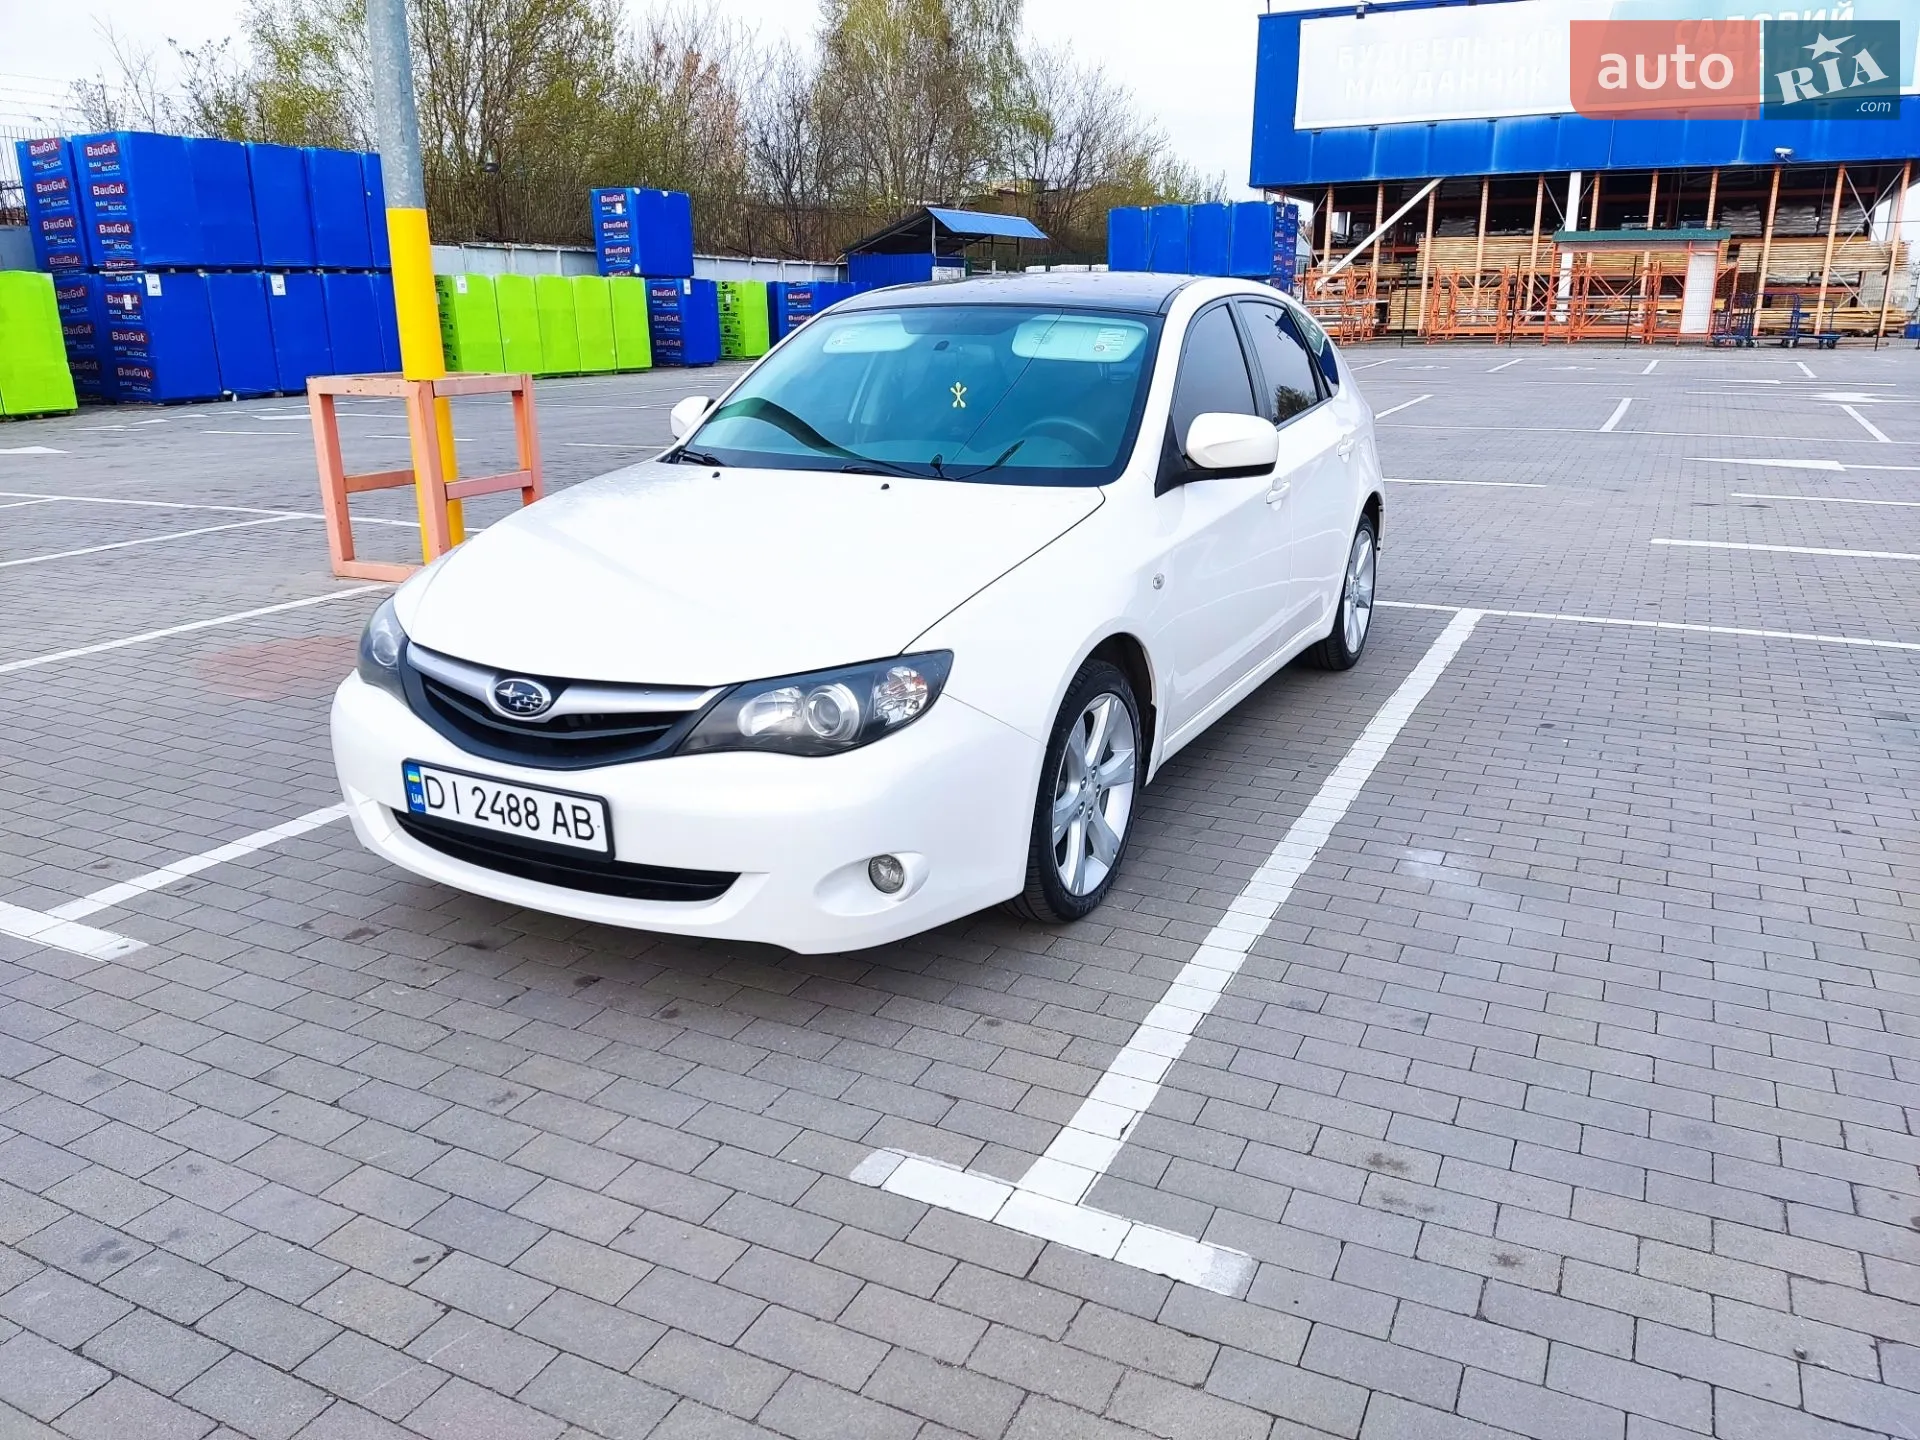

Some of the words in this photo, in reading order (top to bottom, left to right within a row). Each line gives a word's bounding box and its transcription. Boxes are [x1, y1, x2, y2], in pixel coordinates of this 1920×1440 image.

[30, 141, 58, 155] BauGut
[86, 143, 117, 156] BauGut
[43, 160, 62, 169] BLOCK
[101, 164, 120, 172] BLOCK
[36, 179, 67, 193] BauGut
[92, 183, 125, 196] BauGut
[51, 199, 70, 207] BLOCK
[43, 218, 73, 230] BauGut
[99, 223, 131, 234] BauGut
[603, 221, 628, 229] BauGut
[57, 287, 85, 299] BauGut
[107, 294, 138, 304] Bauut
[63, 325, 92, 335] BauGut
[112, 331, 145, 342] BauGut
[117, 367, 151, 378] BauGut
[411, 792, 424, 805] UA
[424, 775, 460, 814] DI
[471, 786, 540, 831] 2488
[552, 801, 595, 841] AB
